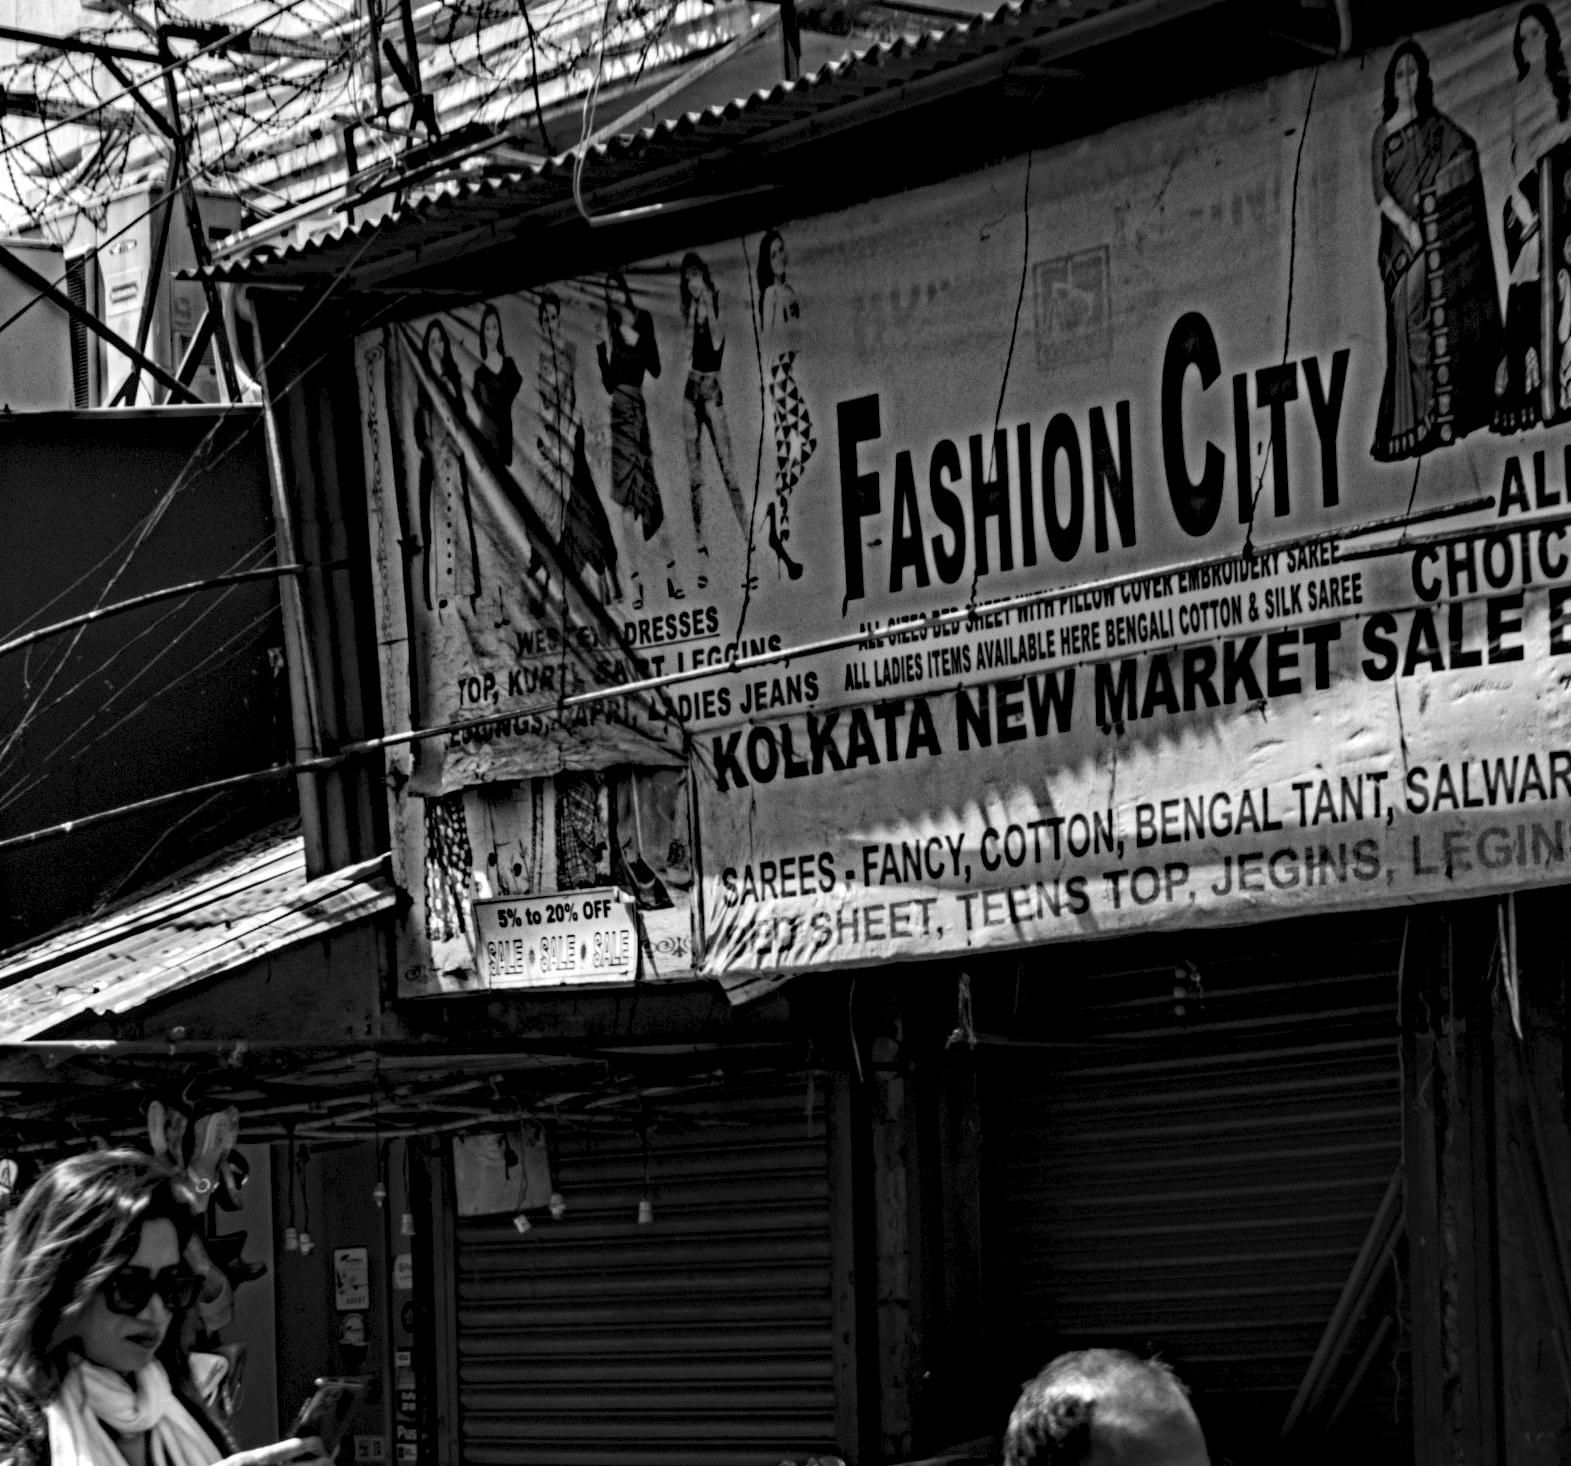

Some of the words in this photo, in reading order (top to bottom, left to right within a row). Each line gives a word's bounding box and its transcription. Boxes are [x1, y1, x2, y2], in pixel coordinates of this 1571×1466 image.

[837, 393, 1137, 600] FASHION
[1161, 311, 1351, 537] CITY
[1121, 573, 1173, 605] COVER
[1179, 552, 1279, 593] EMBROIDERY
[1287, 539, 1342, 573] SAREE
[624, 606, 719, 646] DRESSES
[845, 662, 870, 692] ALL
[874, 653, 923, 688] LADIES
[928, 643, 972, 678] ITEMS
[977, 629, 1056, 672] AVAILABLE
[1060, 622, 1101, 656] HERE
[1105, 607, 1174, 648] BENGALI
[1180, 594, 1242, 635] COTTON
[1248, 591, 1260, 622] &
[1265, 583, 1303, 619] SILK
[1307, 572, 1363, 612] SAREE
[458, 672, 499, 705] TOP,
[712, 700, 941, 791] KOLKATA
[956, 667, 1076, 752] NEW
[1094, 621, 1341, 726] MARKET
[1362, 594, 1524, 682] SALE
[740, 671, 819, 714] JEANS
[722, 851, 836, 908] SAREES
[863, 832, 972, 887] FANCY,
[980, 808, 1124, 871] COTTON,
[1135, 786, 1284, 849] BENGAL
[1291, 770, 1394, 826] TANT,
[497, 908, 522, 928] 5%
[525, 907, 542, 926] to
[545, 902, 578, 923] 20%
[583, 899, 611, 920] OFF
[955, 876, 1090, 935] TEENS
[1103, 861, 1196, 909] TOP,
[1212, 838, 1396, 899] JEGINS,
[487, 939, 523, 976] SALE
[540, 934, 576, 973] SALE
[592, 930, 629, 968] SALE
